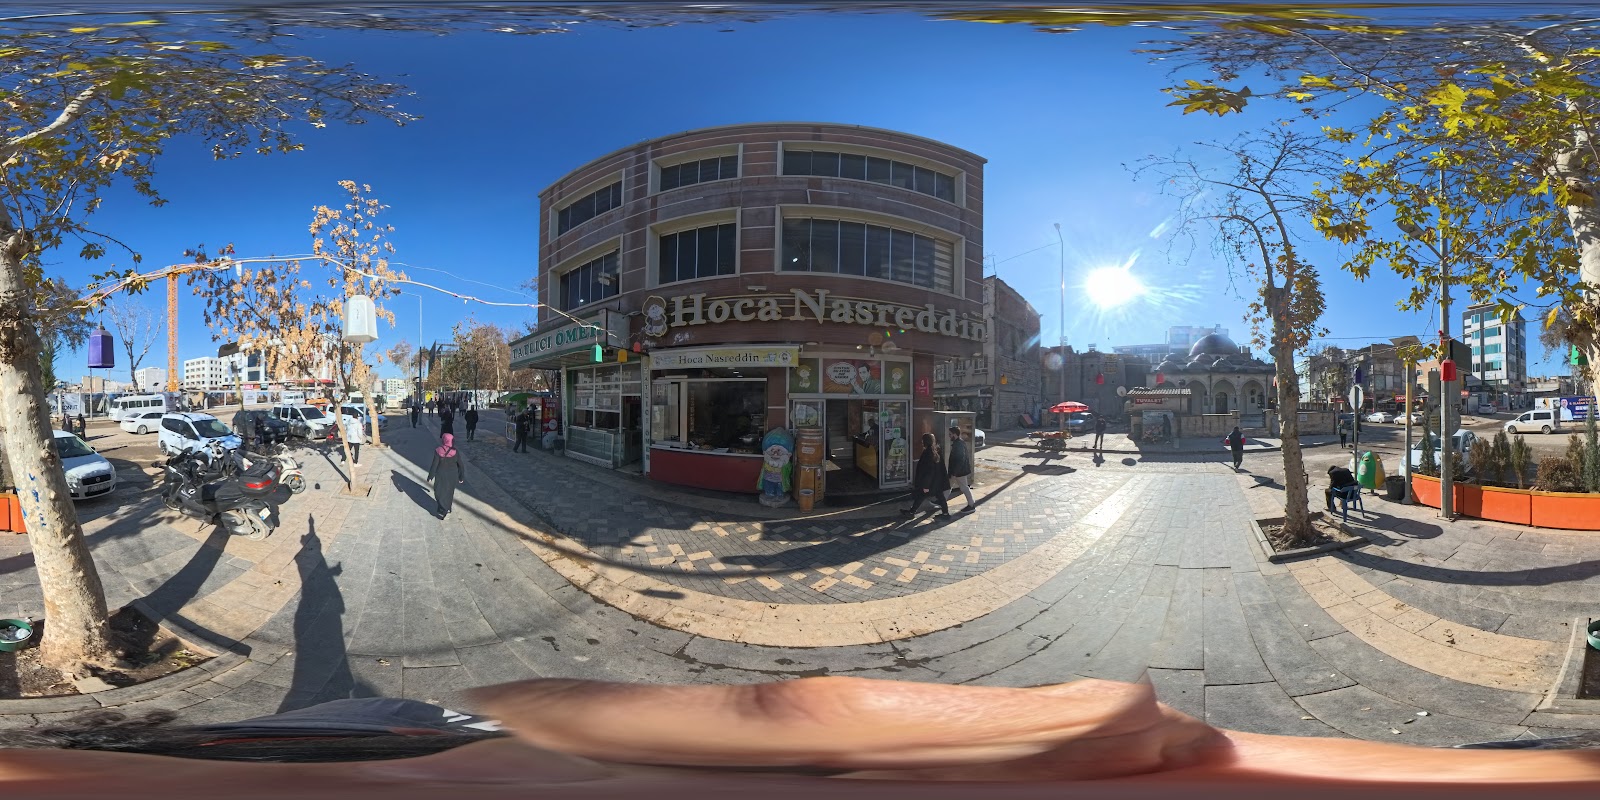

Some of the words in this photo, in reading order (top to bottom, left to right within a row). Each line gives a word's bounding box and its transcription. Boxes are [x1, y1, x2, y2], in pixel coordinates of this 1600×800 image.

[670, 292, 782, 328] Hoca
[789, 288, 989, 343] Nasreddin
[512, 334, 552, 359] TATLICI
[678, 355, 703, 365] Hoca
[705, 353, 760, 364] Nasreddin
